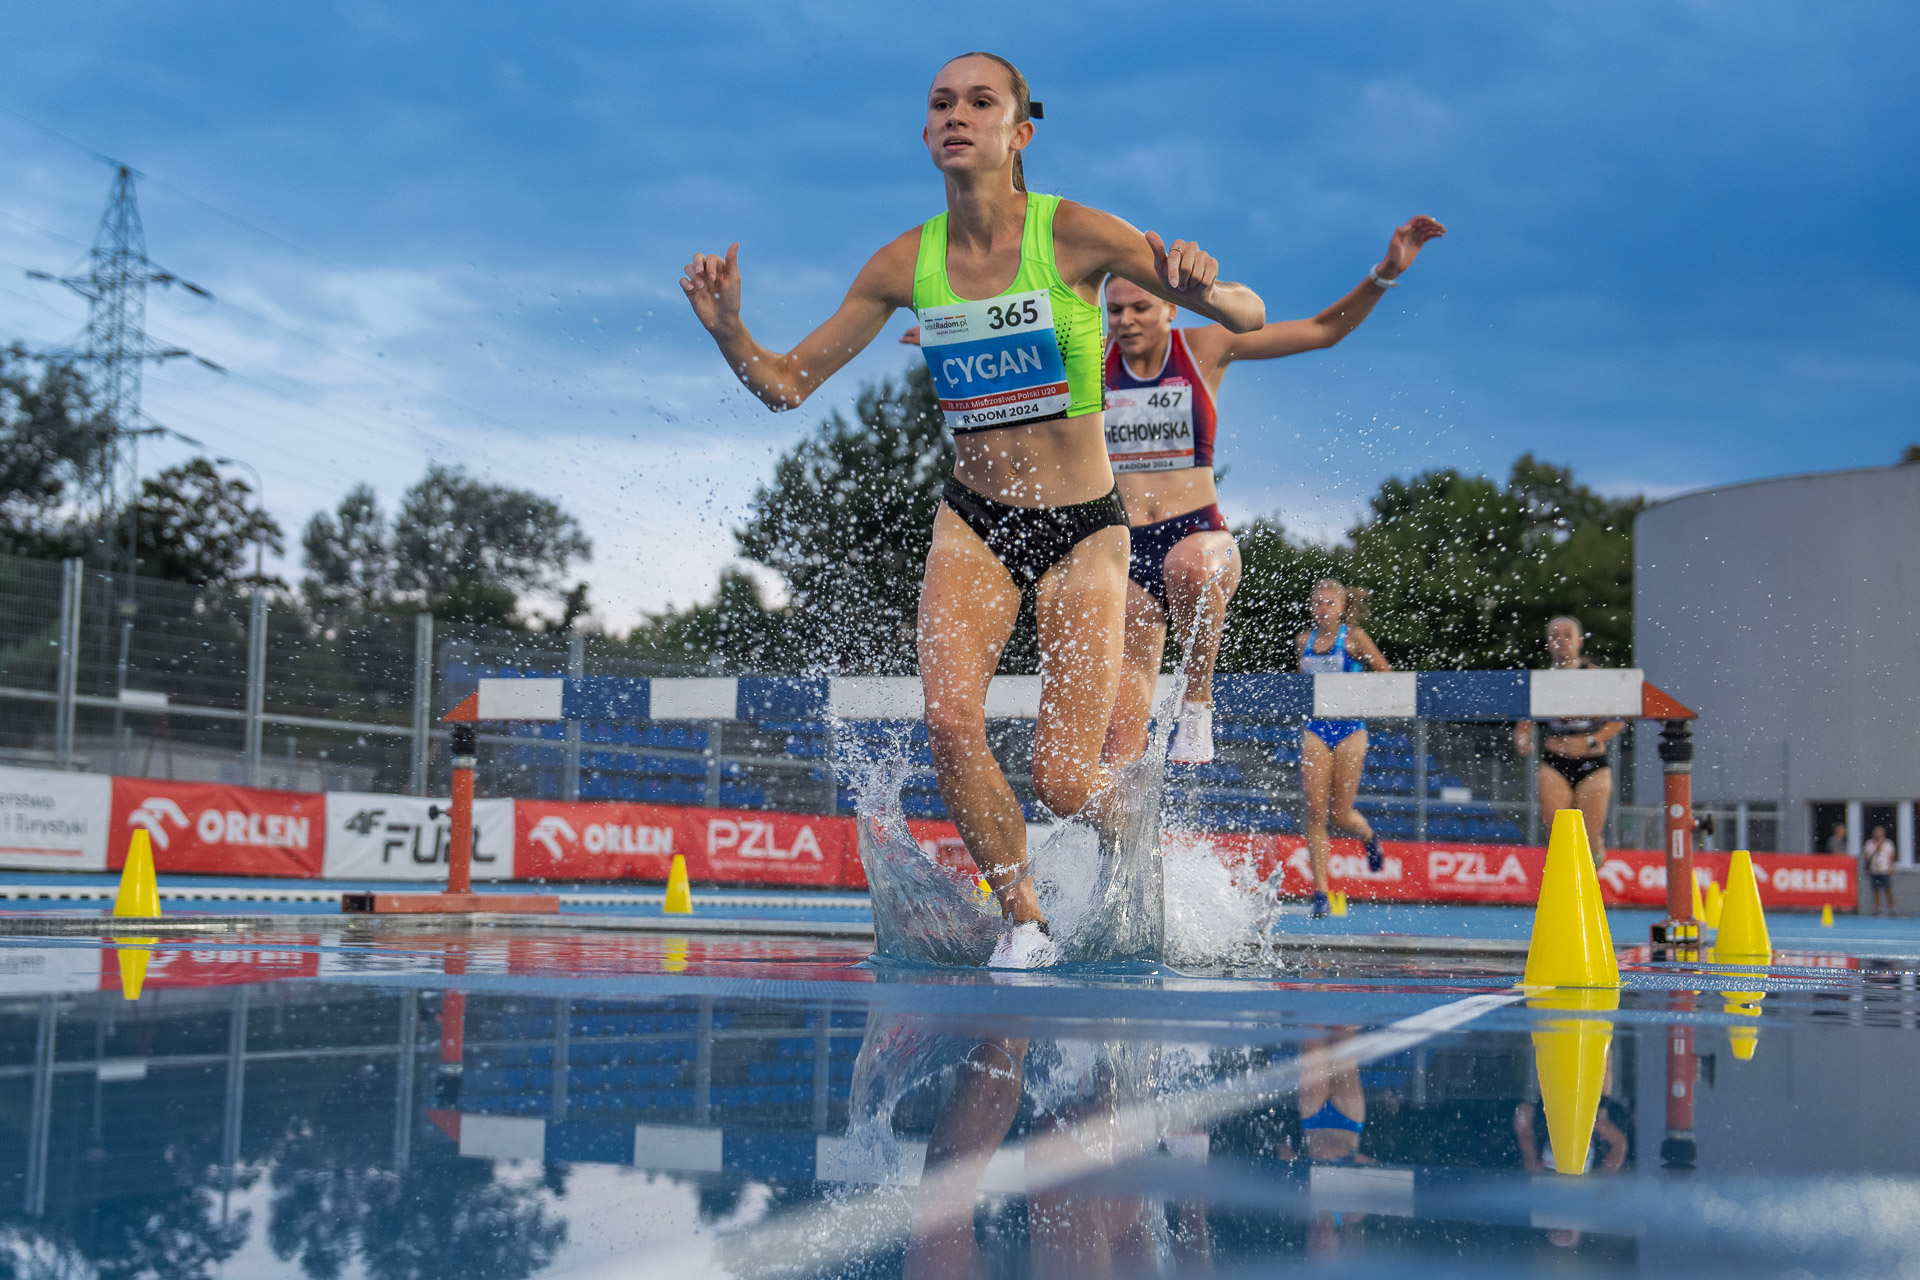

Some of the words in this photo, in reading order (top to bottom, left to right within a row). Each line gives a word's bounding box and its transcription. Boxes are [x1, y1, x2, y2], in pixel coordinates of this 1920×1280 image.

[924, 319, 968, 331] visitRadom.pl
[987, 299, 1039, 330] 365
[942, 345, 1043, 385] CYGAN
[971, 395, 1016, 408] Mistrzostwa
[1017, 390, 1040, 400] Polski
[1041, 386, 1057, 396] U20
[1147, 392, 1183, 408] 467
[963, 409, 1007, 424] RADOM
[1009, 403, 1040, 417] 2024
[1105, 420, 1191, 443] IECHOWSKA
[1119, 461, 1150, 470] RADOM
[1153, 460, 1174, 468] 2024
[197, 809, 310, 849] ORLEN
[583, 823, 674, 855] ORLEN
[707, 819, 824, 861] PZLA
[1428, 850, 1529, 883] PZLA
[1772, 867, 1848, 893] ORLEN
